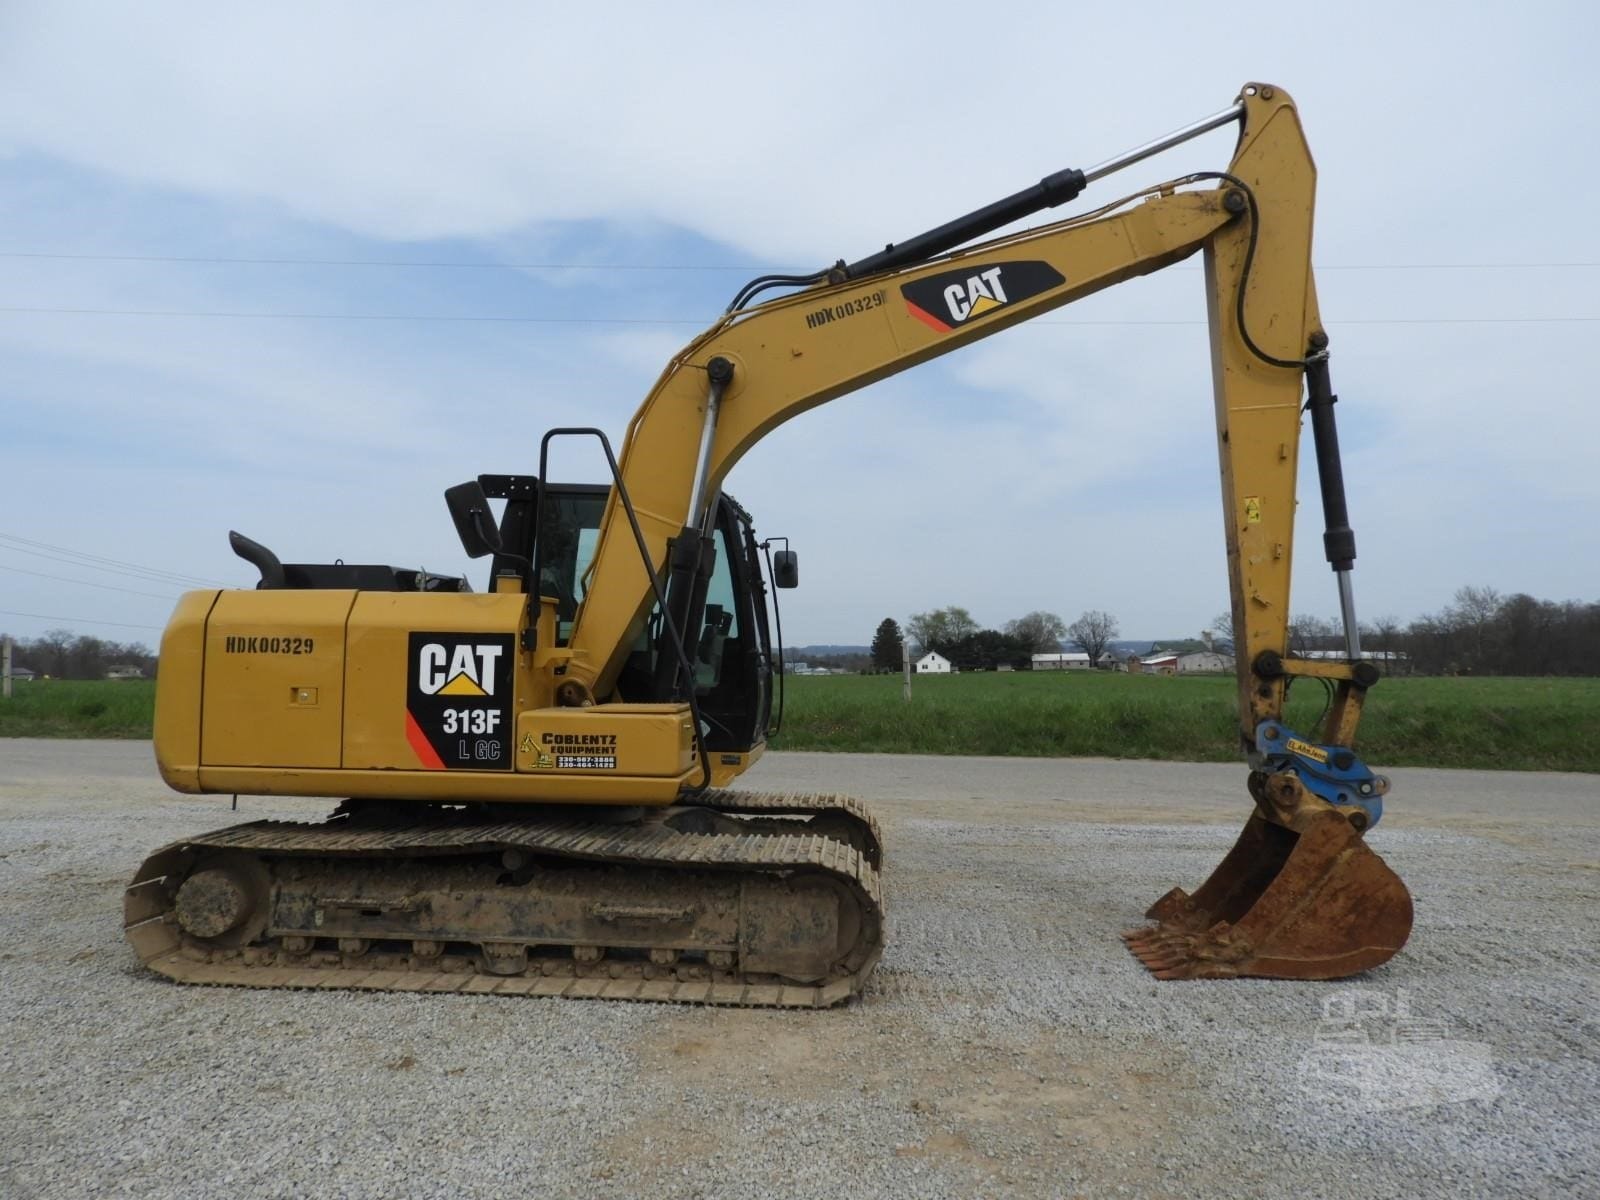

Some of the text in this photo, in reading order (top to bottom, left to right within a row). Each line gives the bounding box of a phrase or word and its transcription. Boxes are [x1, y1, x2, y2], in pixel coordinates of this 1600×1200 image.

[943, 266, 1008, 322] CAT
[806, 289, 884, 329] HDK00329
[226, 636, 313, 655] HDK00329
[418, 643, 503, 696] CAT
[442, 708, 501, 734] 313F
[459, 739, 501, 760] L GC
[551, 745, 617, 755] EQUIPMENT
